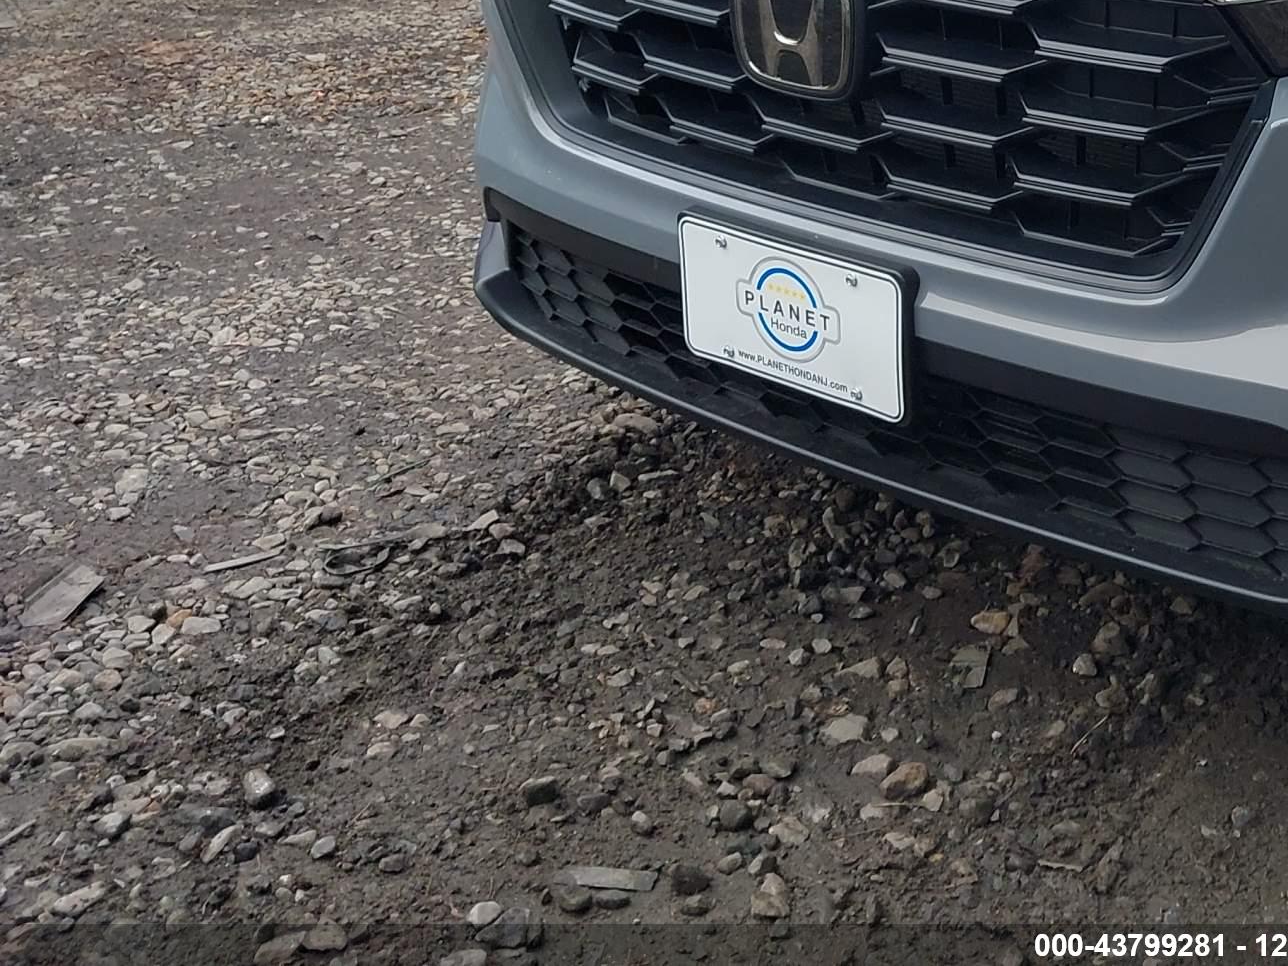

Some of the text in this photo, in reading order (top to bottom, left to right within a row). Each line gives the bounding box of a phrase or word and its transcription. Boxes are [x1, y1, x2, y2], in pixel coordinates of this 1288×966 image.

[744, 290, 830, 331] PLANET
[771, 317, 808, 339] Honda
[737, 349, 849, 393] www.PLANETHONDANJ.com
